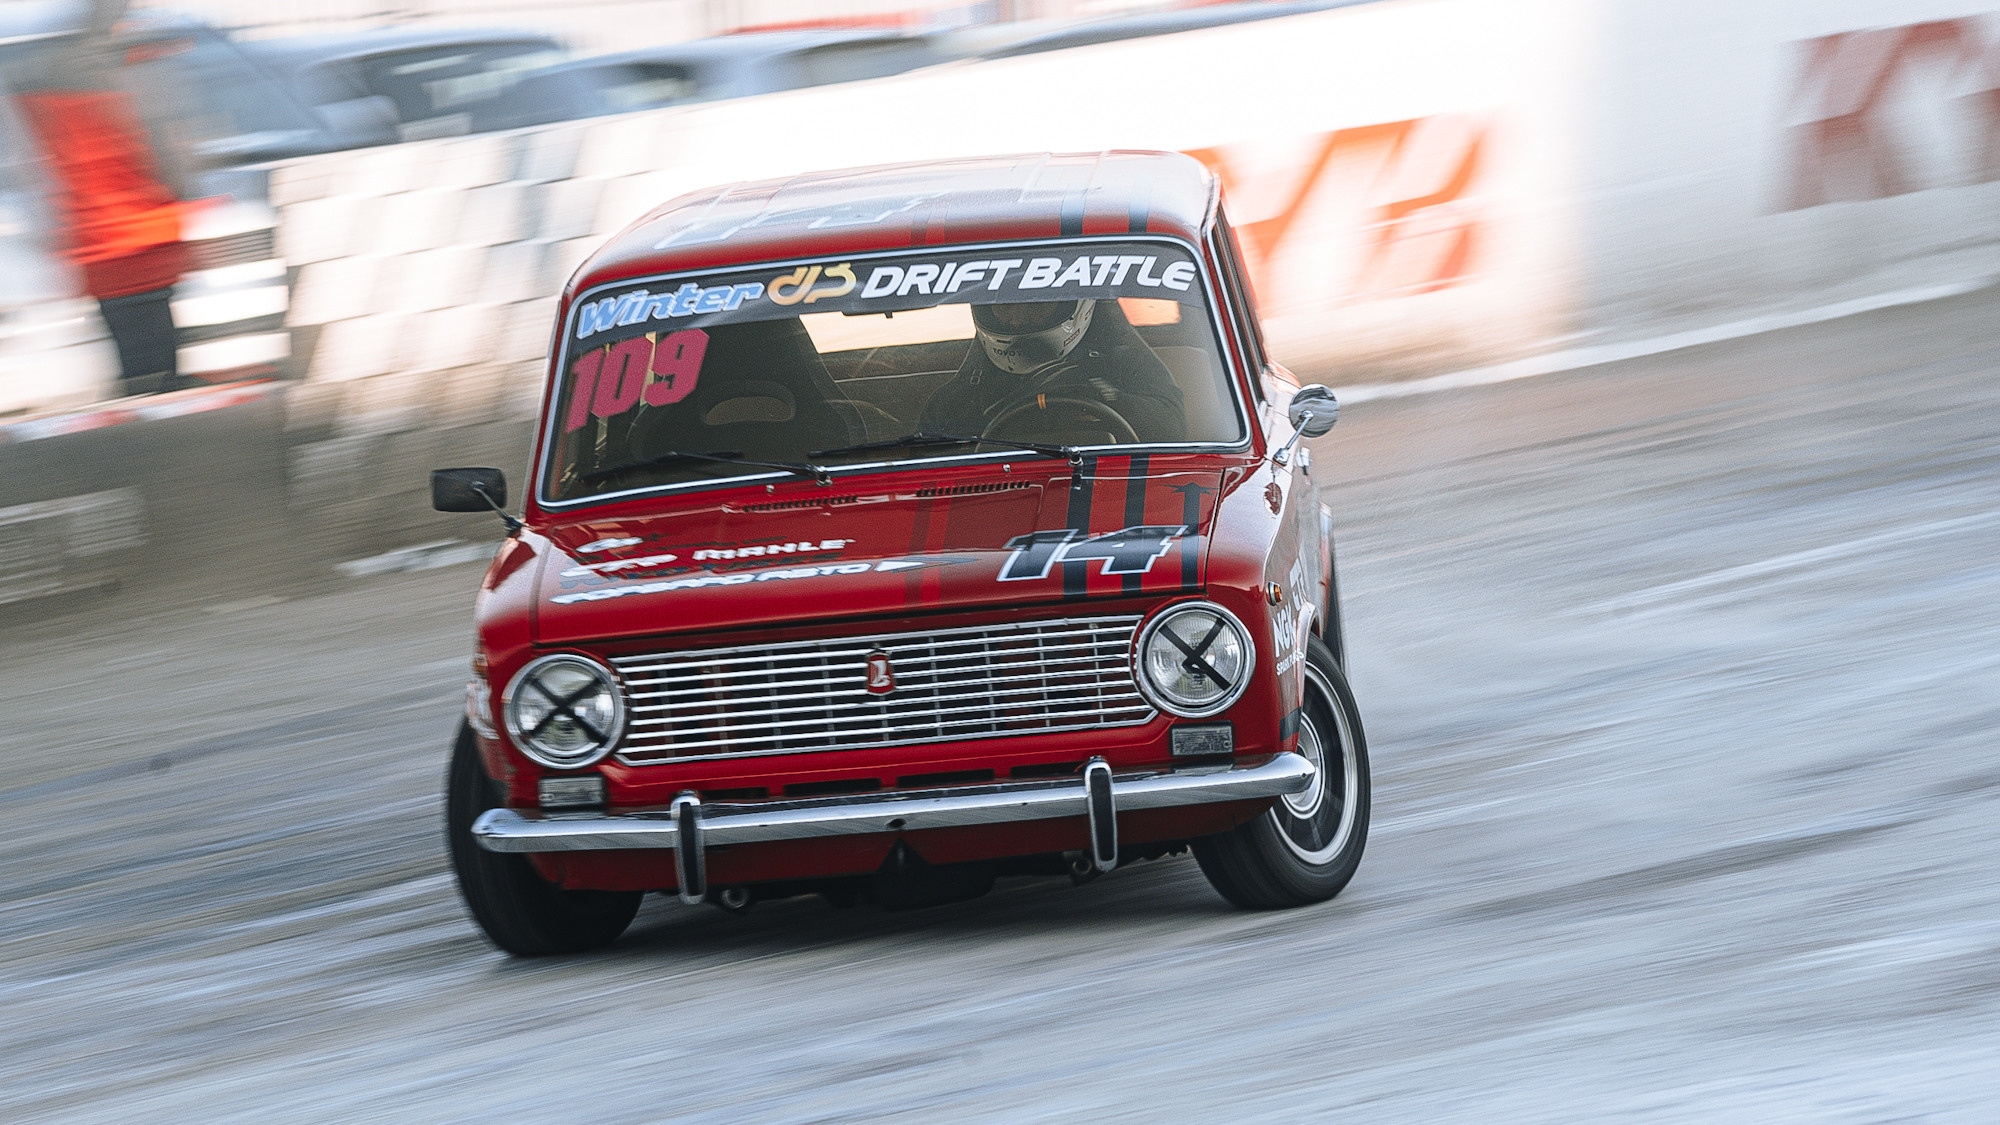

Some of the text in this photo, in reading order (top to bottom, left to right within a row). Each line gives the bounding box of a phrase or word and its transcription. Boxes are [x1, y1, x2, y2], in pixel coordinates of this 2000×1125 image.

[577, 283, 765, 340] Winter
[860, 258, 1023, 299] DRIFT
[1018, 255, 1197, 292] BATTLE
[566, 328, 710, 433] 109
[996, 525, 1189, 582] 14
